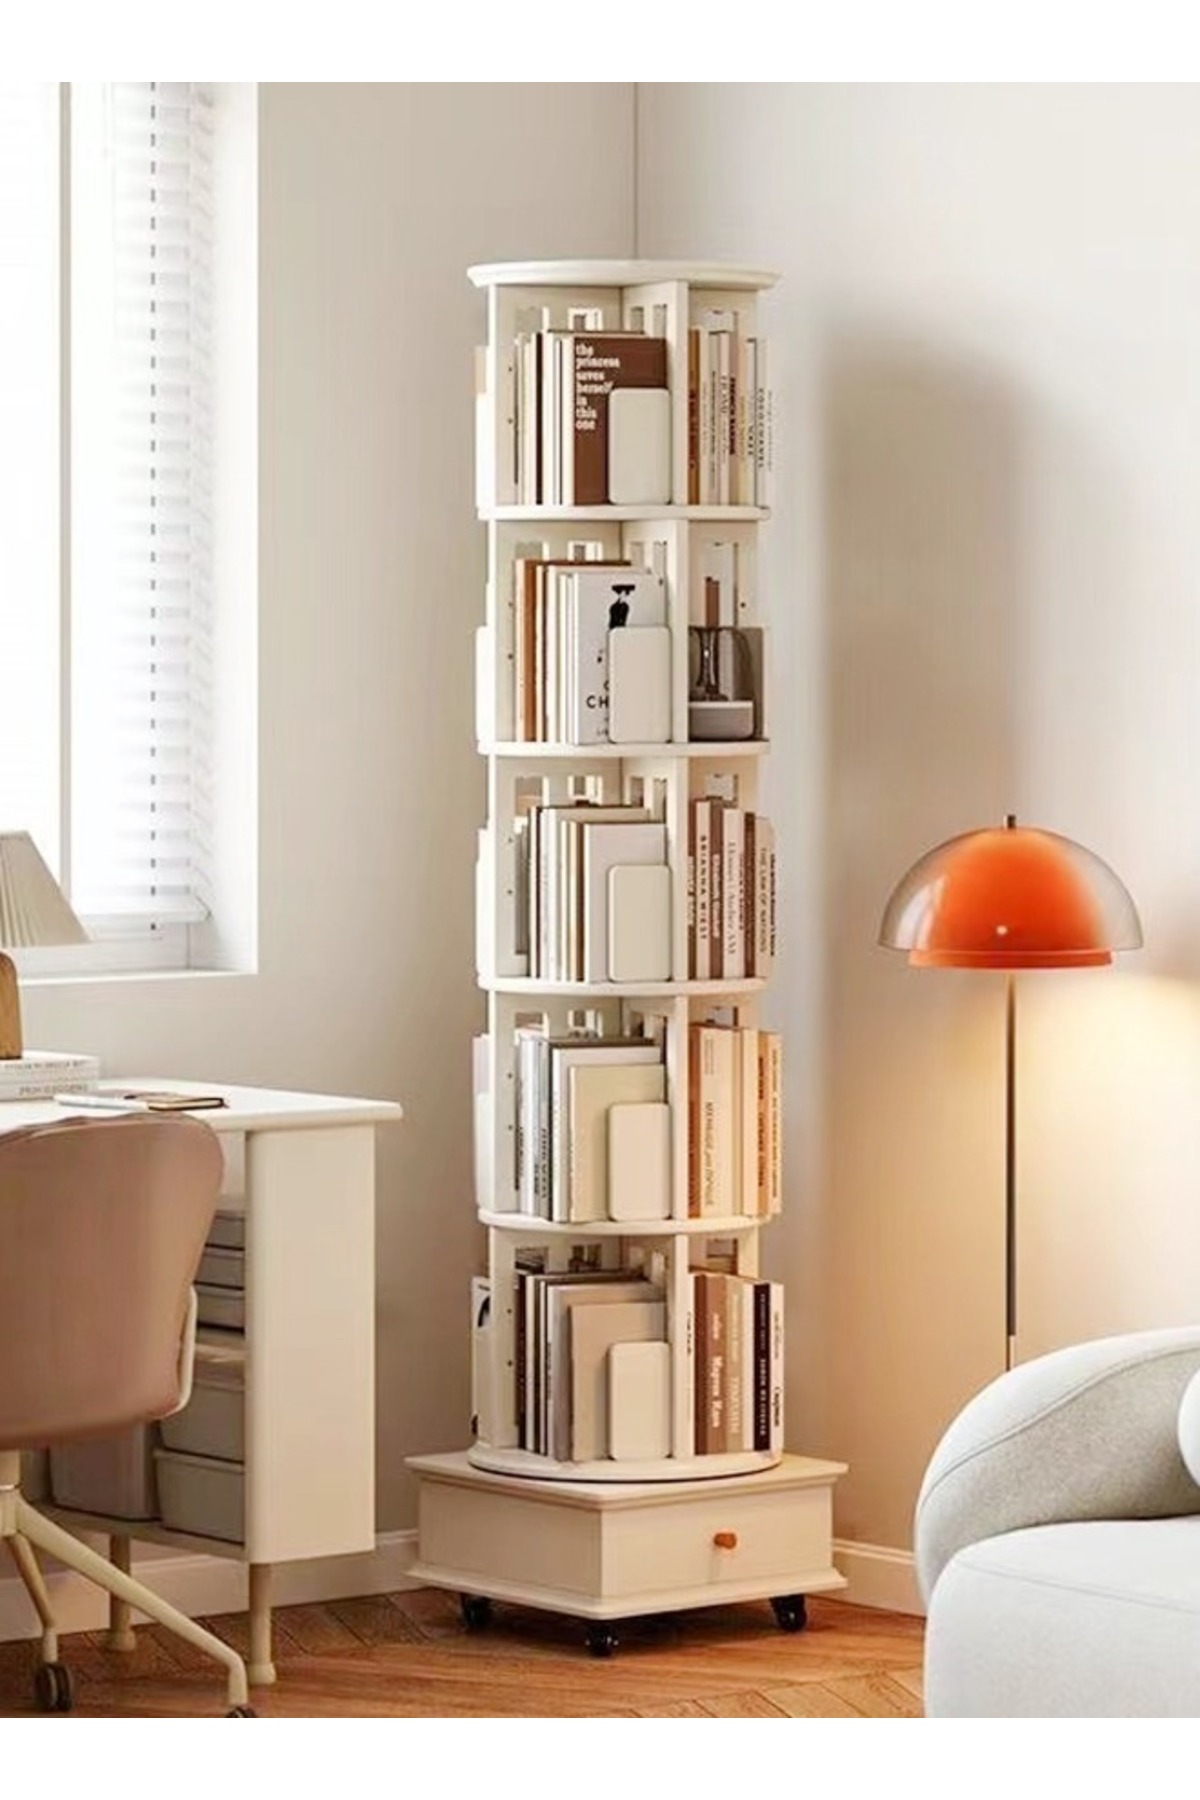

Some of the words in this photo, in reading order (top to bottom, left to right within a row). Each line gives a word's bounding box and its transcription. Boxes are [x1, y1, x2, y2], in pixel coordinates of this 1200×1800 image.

[576, 343, 594, 356] the
[575, 357, 620, 370] princess
[576, 371, 604, 381] saves
[576, 381, 613, 394] herself
[576, 396, 588, 406] in
[576, 406, 597, 419] this
[576, 420, 595, 430] one
[760, 892, 767, 906] OF
